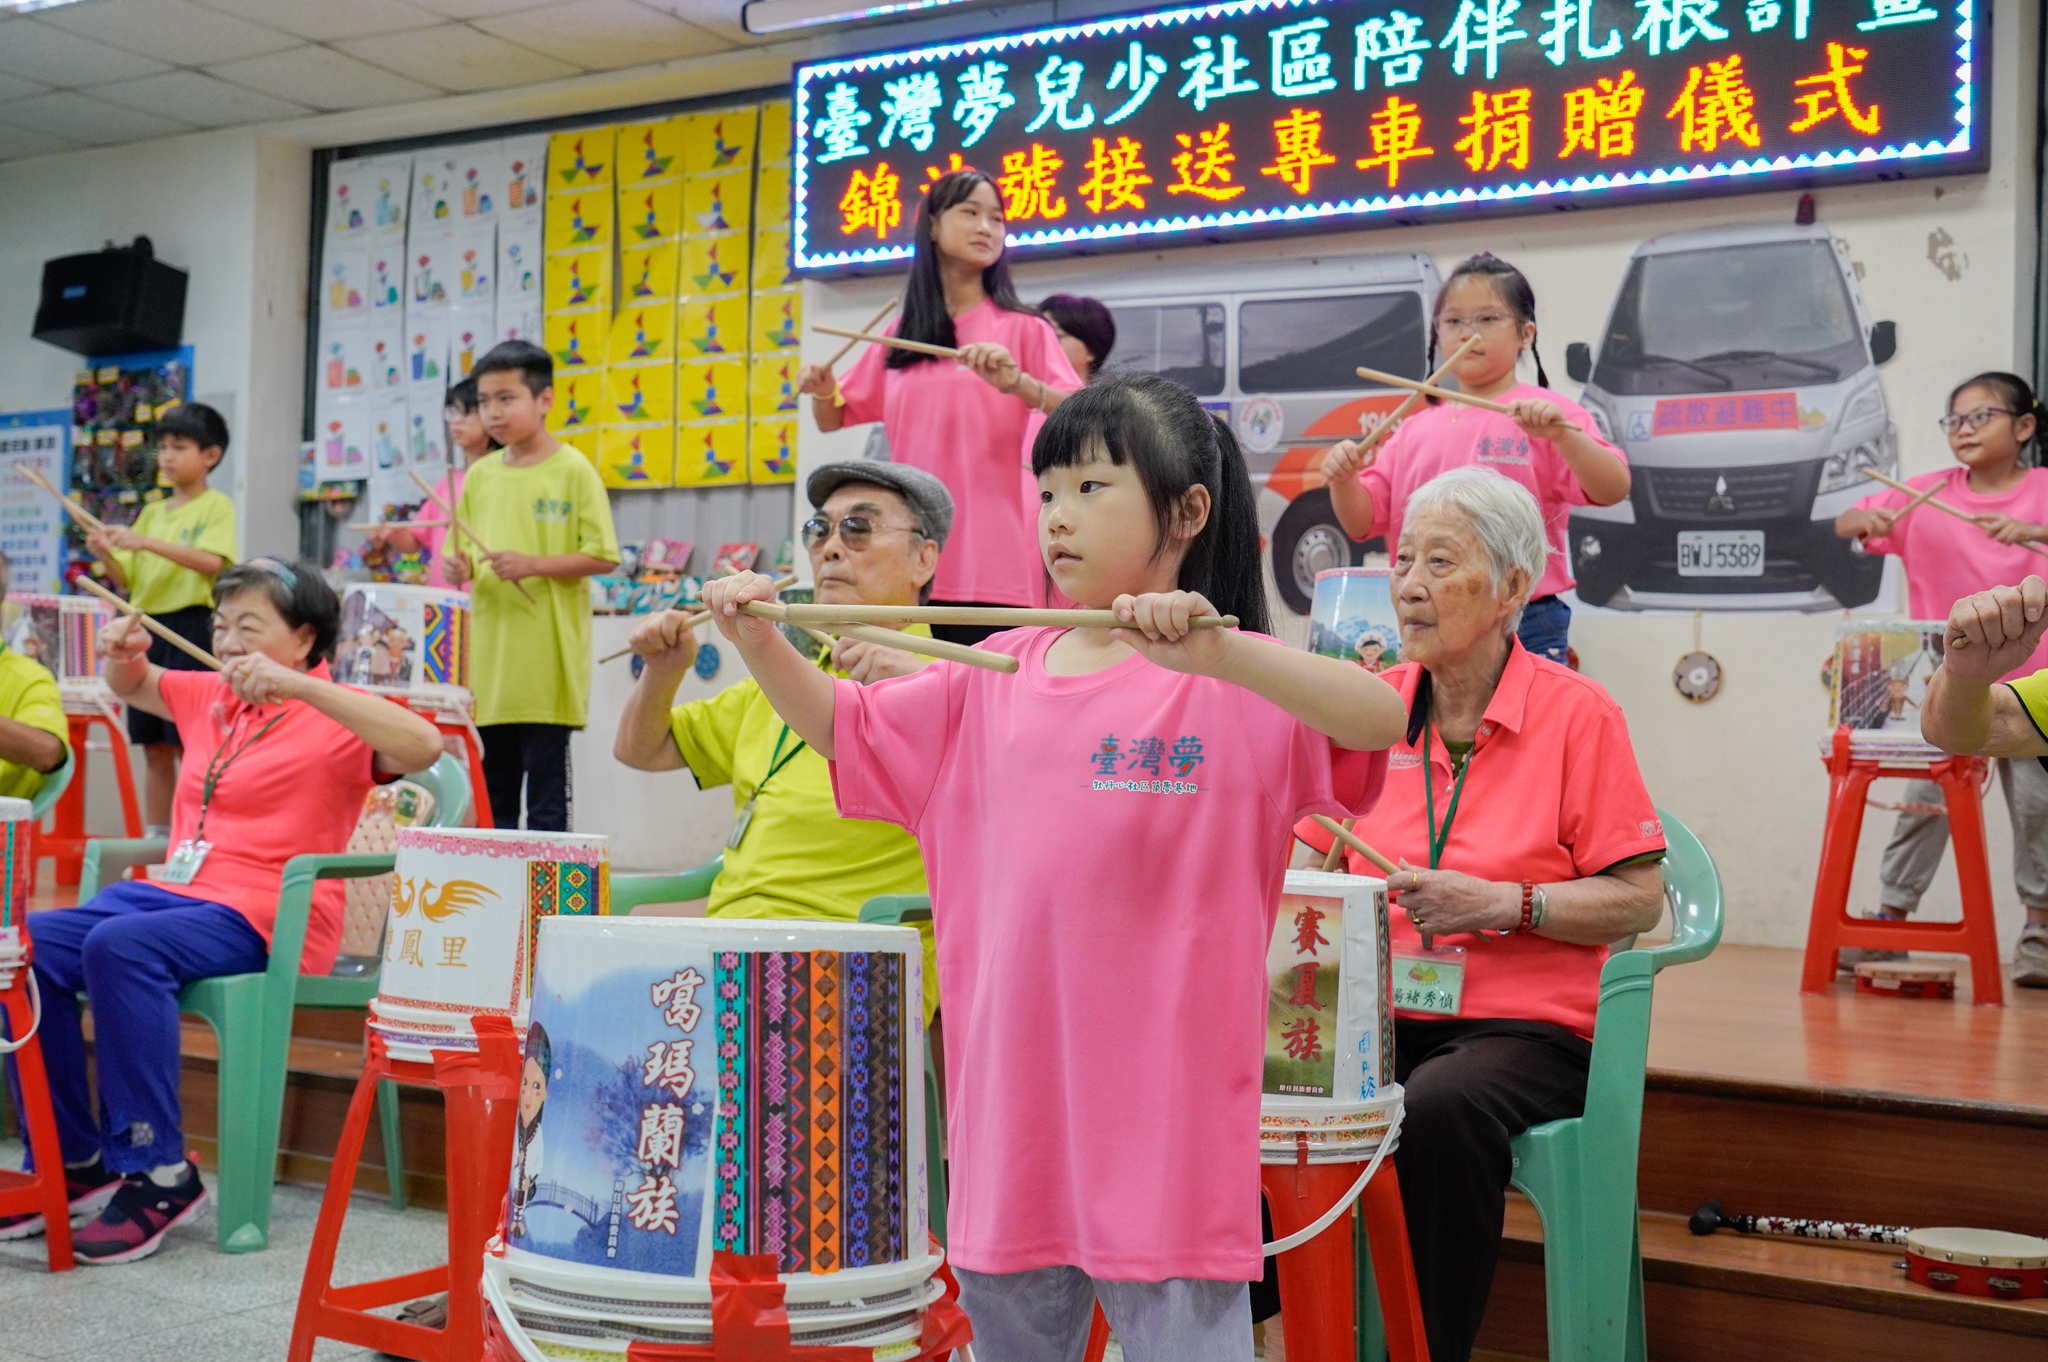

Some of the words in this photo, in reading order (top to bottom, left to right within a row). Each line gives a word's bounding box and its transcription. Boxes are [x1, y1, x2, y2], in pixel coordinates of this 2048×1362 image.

[839, 42, 1881, 239] 錦號接送專車捐贈儀式
[1657, 396, 1795, 429] 疏散避難中
[1090, 733, 1204, 777] 臺灣夢
[1281, 906, 1330, 1062] 賽夏族
[626, 967, 704, 1235] 噶瑪蘭族
